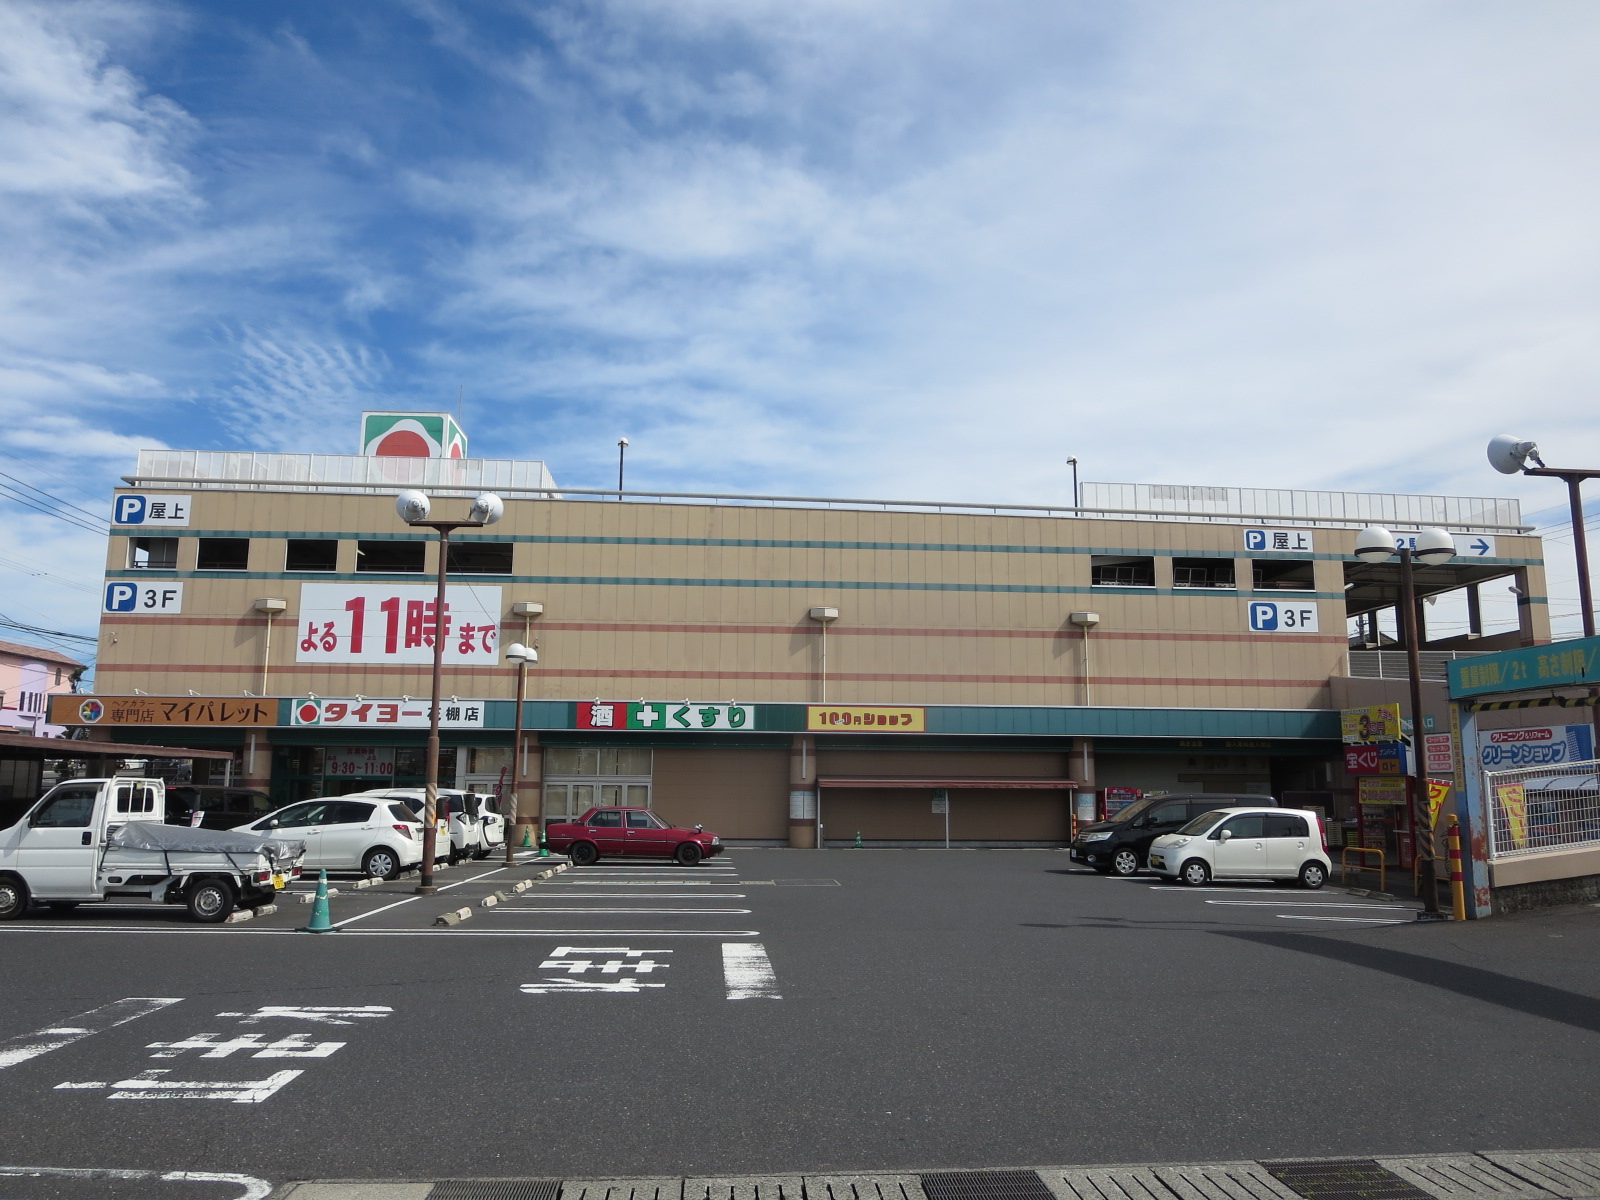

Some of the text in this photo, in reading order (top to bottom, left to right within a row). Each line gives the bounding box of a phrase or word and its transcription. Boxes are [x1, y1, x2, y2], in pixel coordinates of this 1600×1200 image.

[121, 499, 184, 521] P 屋上
[1249, 533, 1309, 550] P 屋上
[112, 586, 178, 610] P 3F
[1256, 606, 1313, 629] P 3F
[111, 709, 154, 723] 専門店
[161, 701, 268, 723] マイパレット
[324, 703, 423, 723] タイヨー
[590, 704, 614, 728] 酒
[673, 705, 746, 728] くすり
[1347, 752, 1378, 769] 宝くじ
[1482, 741, 1566, 765] クリーンショップ
